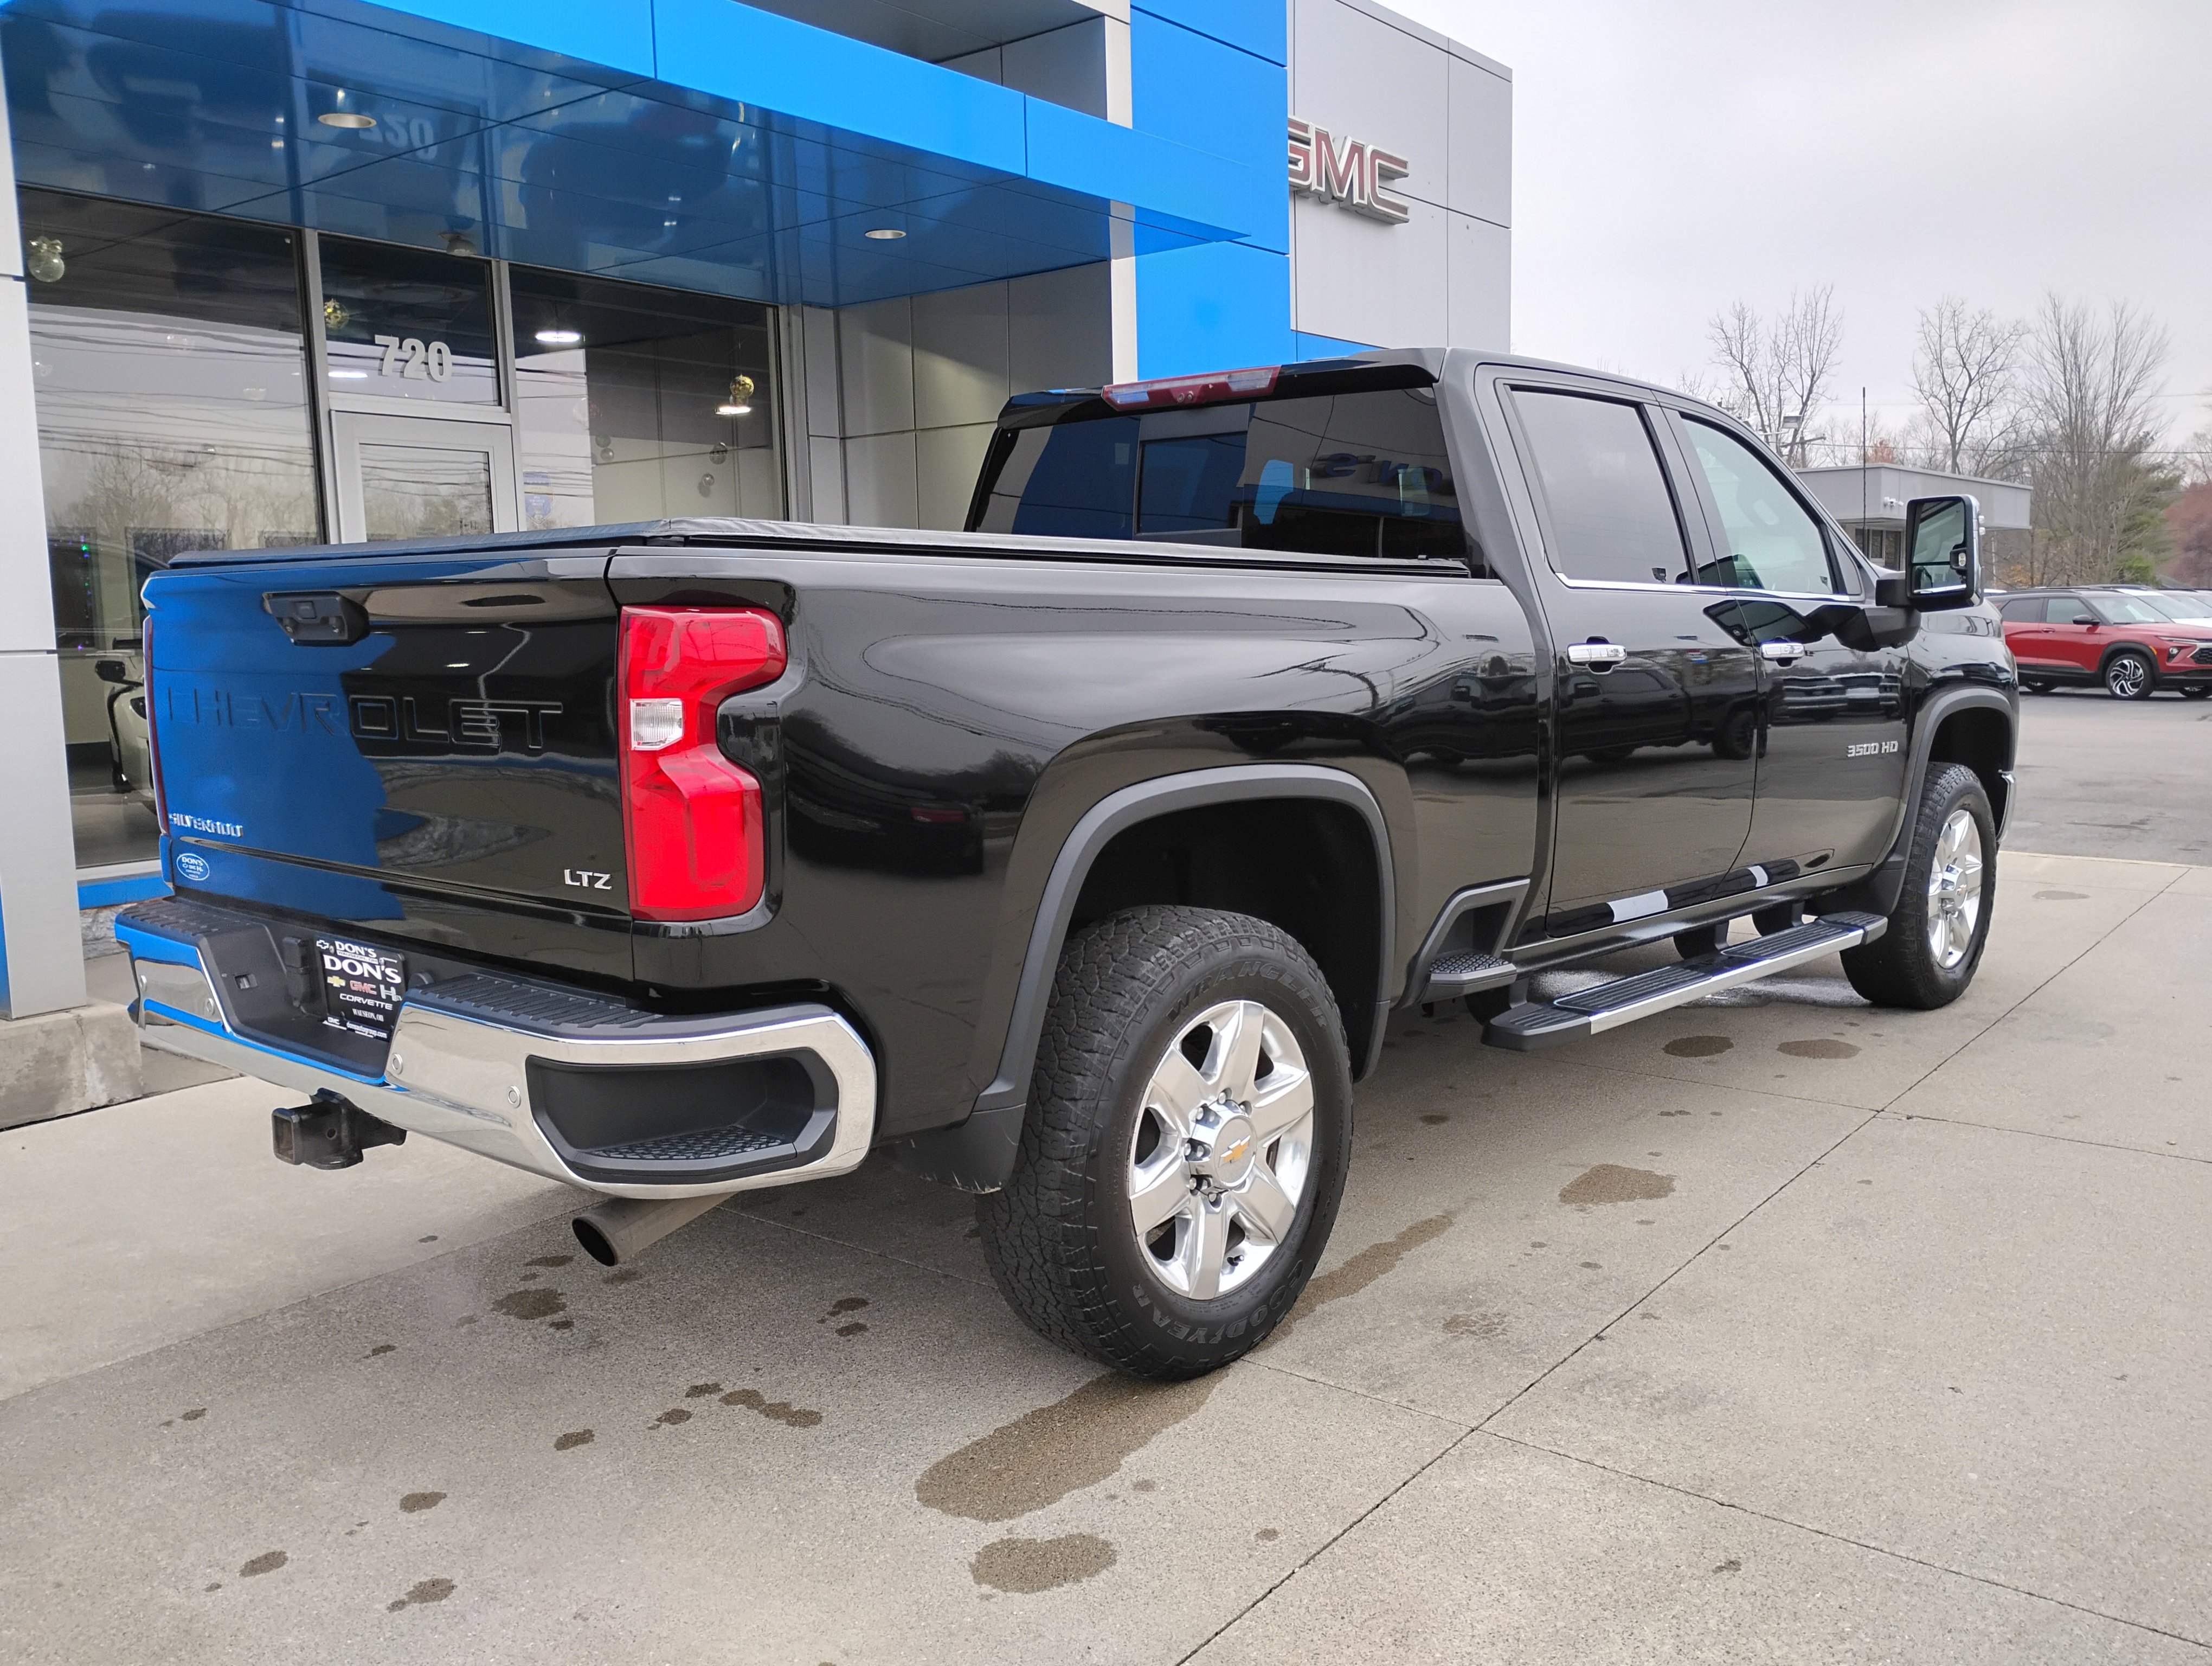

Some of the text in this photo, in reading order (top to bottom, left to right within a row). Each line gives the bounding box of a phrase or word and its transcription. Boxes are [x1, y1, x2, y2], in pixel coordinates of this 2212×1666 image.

[375, 334, 452, 382] 720
[168, 687, 563, 748] CHEVROLET
[1847, 741, 1898, 758] 3500 HD
[564, 869, 613, 889] LTZ
[335, 940, 377, 958] DON'S
[323, 954, 402, 984] DON'S
[350, 980, 377, 995] GMC
[1166, 962, 1327, 1028] WRANGLER
[340, 993, 393, 1010] CORVETTE
